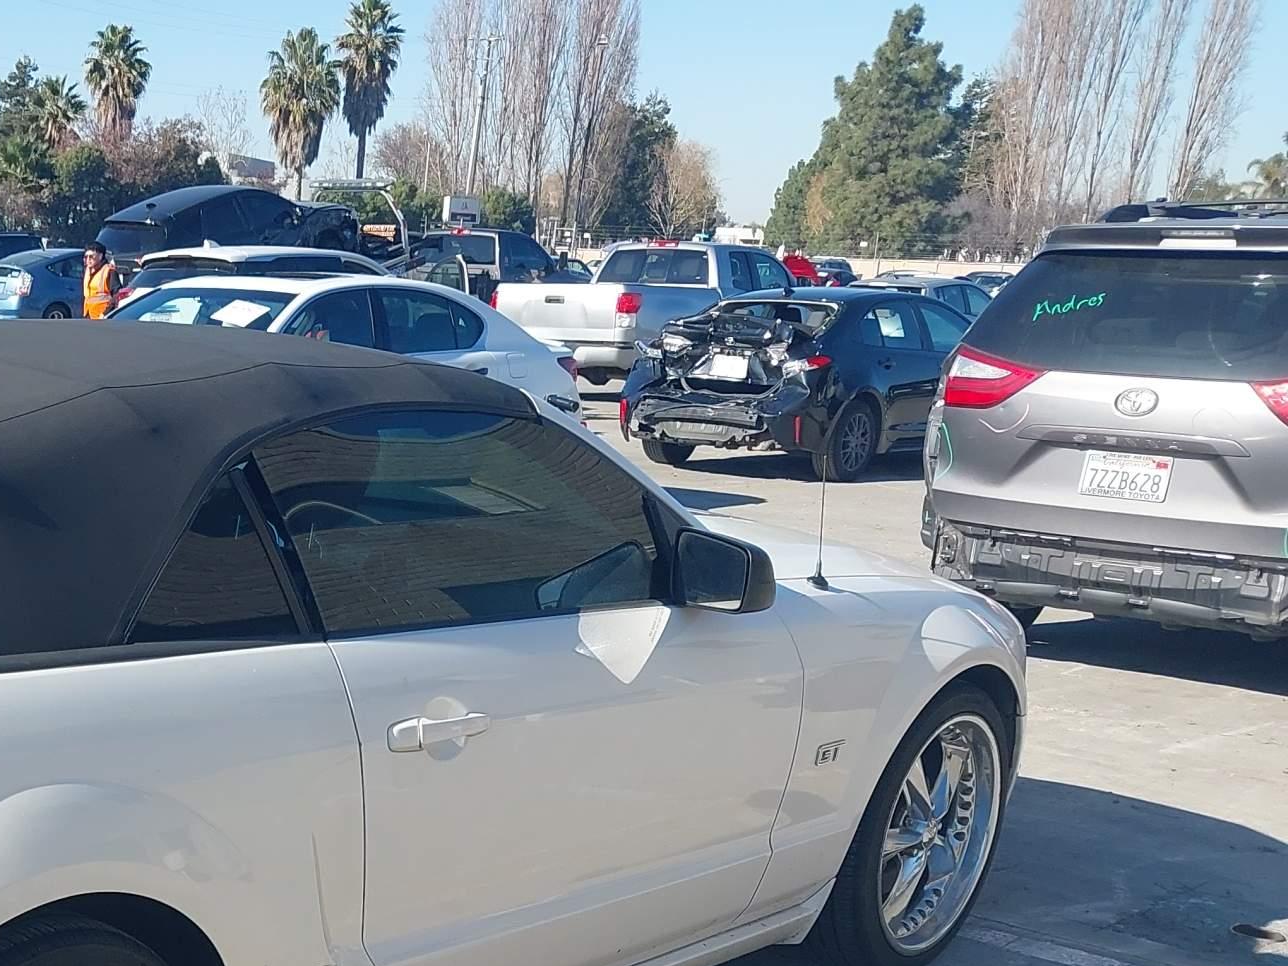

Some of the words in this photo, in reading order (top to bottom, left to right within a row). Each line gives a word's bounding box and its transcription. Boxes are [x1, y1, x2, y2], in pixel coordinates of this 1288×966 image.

[1032, 292, 1107, 322] Andres
[1080, 487, 1127, 498] LIVERMORE
[1128, 491, 1161, 501] TOYOTA
[1088, 468, 1162, 494] 7ZZB628
[815, 738, 847, 767] GT
